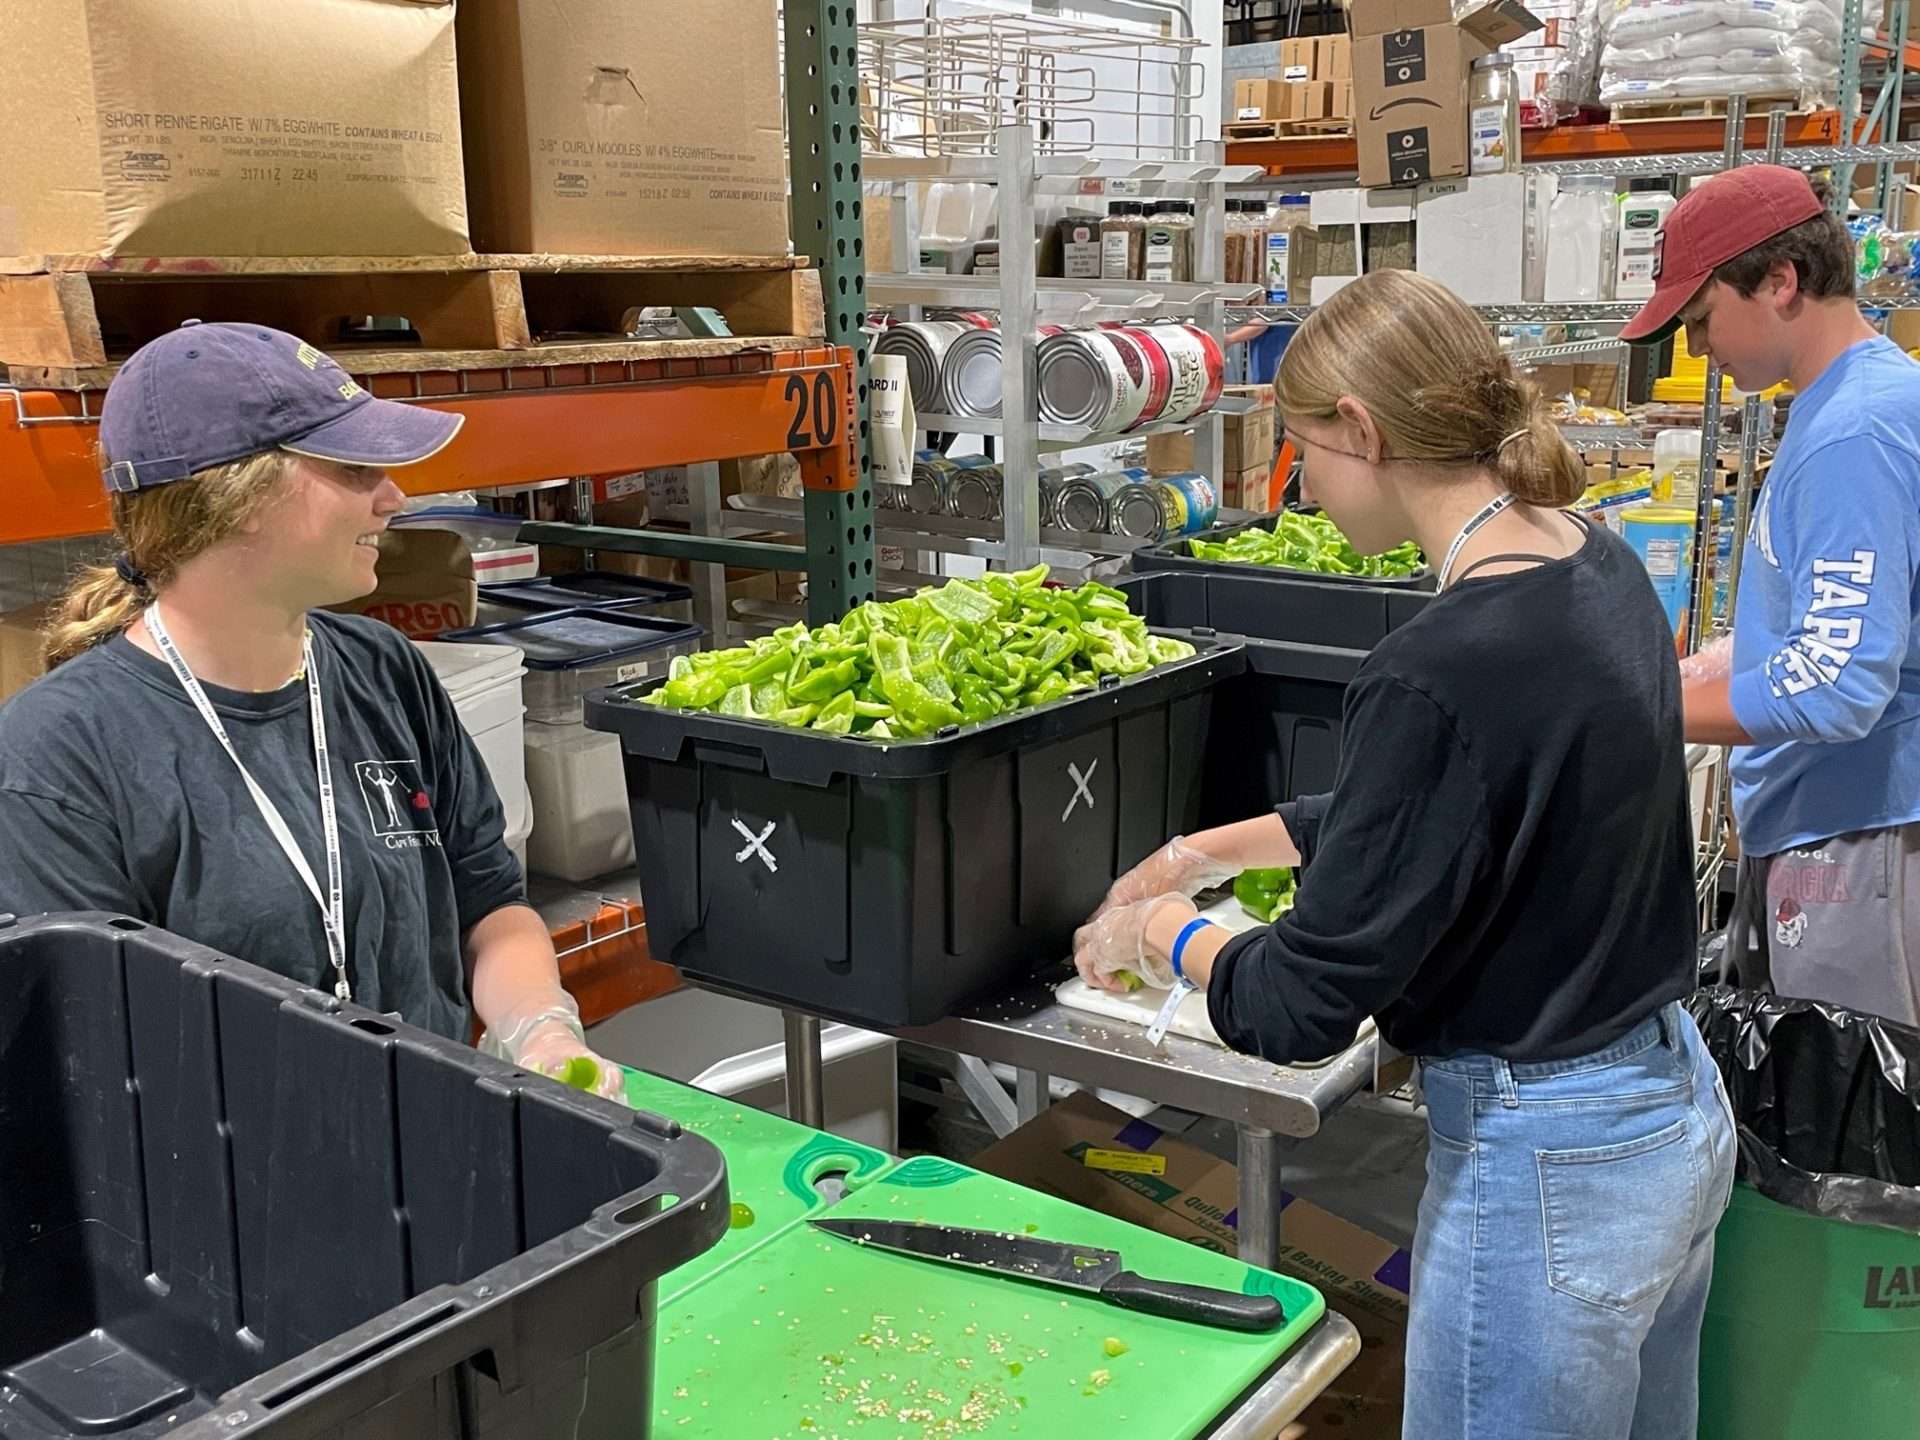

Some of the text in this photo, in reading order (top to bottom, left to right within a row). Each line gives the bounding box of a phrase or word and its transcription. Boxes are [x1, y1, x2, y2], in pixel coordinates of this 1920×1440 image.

[105, 112, 152, 129] SHORT
[155, 114, 198, 130] PENNE
[201, 116, 243, 132] RIGATE
[283, 119, 341, 137] EGGWHITE
[345, 126, 389, 139] CONTAINS
[391, 129, 418, 141] WHEAT
[1821, 117, 1831, 138] 4
[562, 140, 595, 154] CURLY
[597, 142, 641, 157] NOODLES
[785, 371, 837, 449] 20
